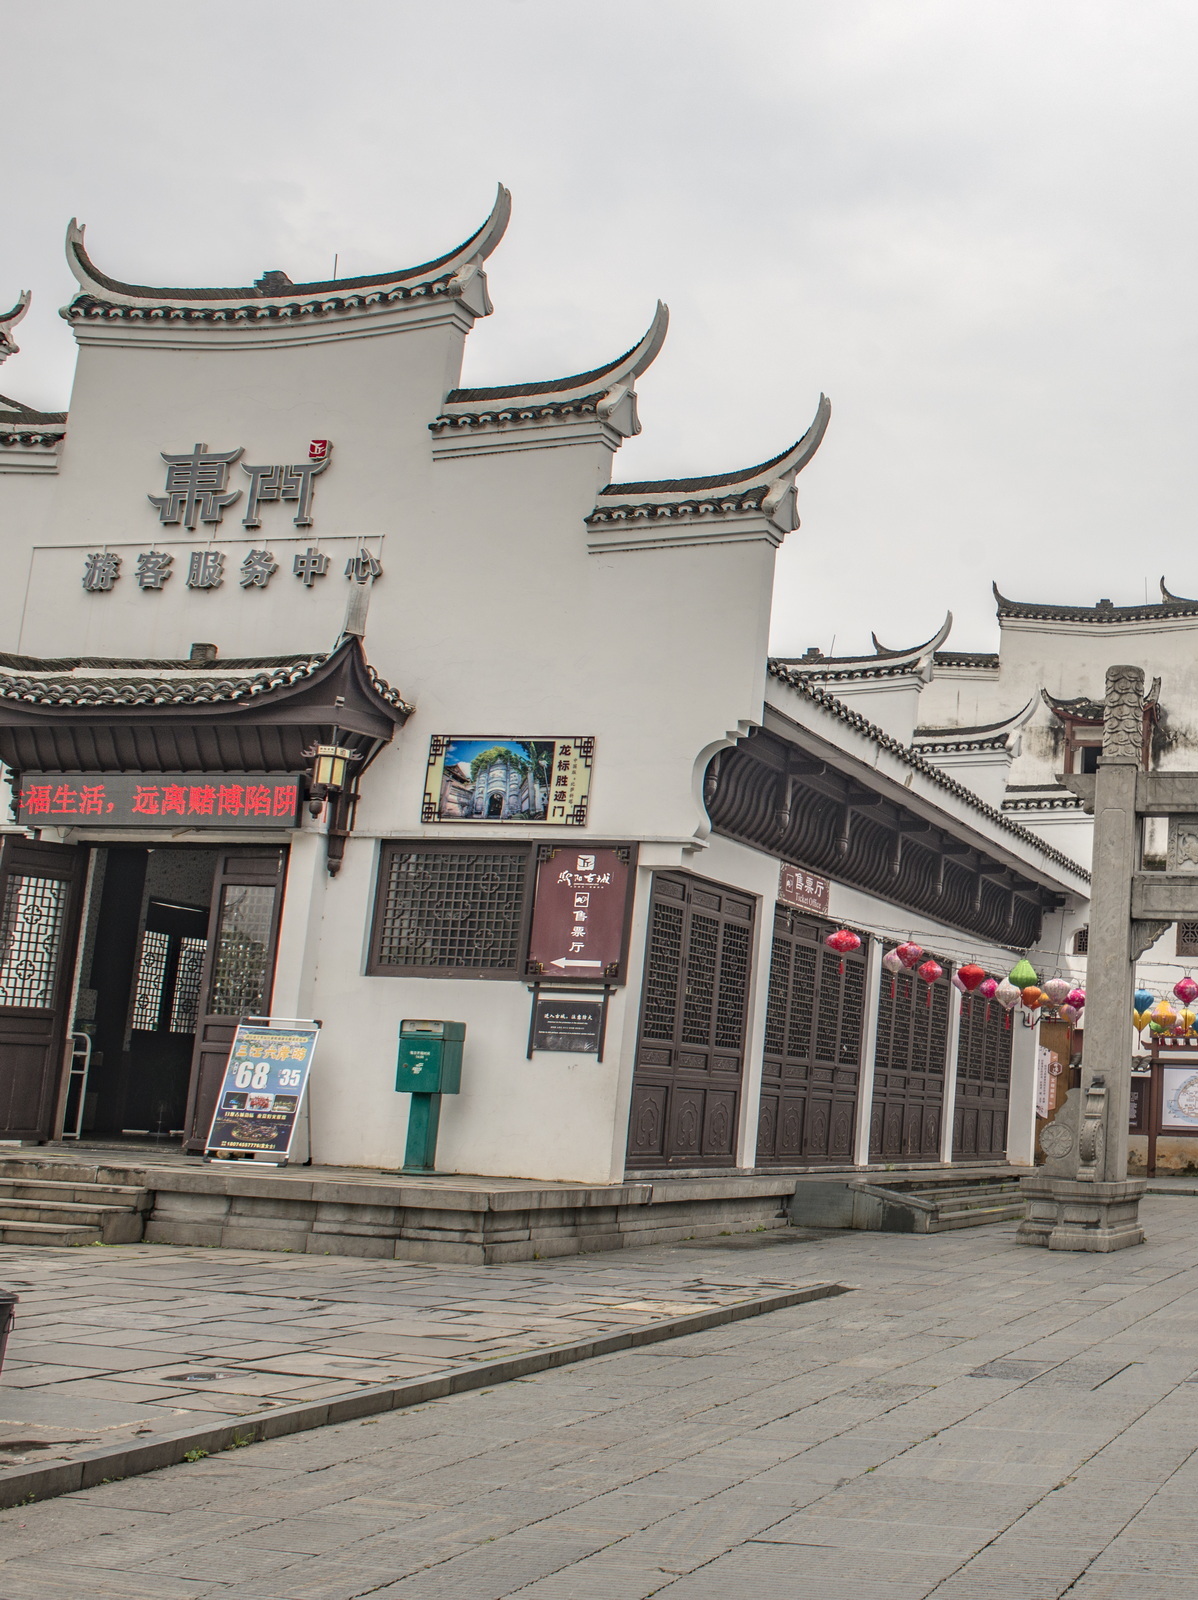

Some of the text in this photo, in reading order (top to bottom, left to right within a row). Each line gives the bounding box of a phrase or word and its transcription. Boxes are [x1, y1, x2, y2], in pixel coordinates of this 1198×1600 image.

[82, 547, 384, 592] 游客服务中心
[552, 744, 572, 817] 龙标胜迹门
[19, 783, 297, 817] 福生活，远离赌博陷阱
[795, 872, 825, 898] 售票厅
[808, 897, 822, 909] Office
[569, 910, 588, 953] 售票厅
[236, 1045, 307, 1061] 三江六岸游
[235, 1061, 271, 1089] 68
[279, 1068, 301, 1087] 35
